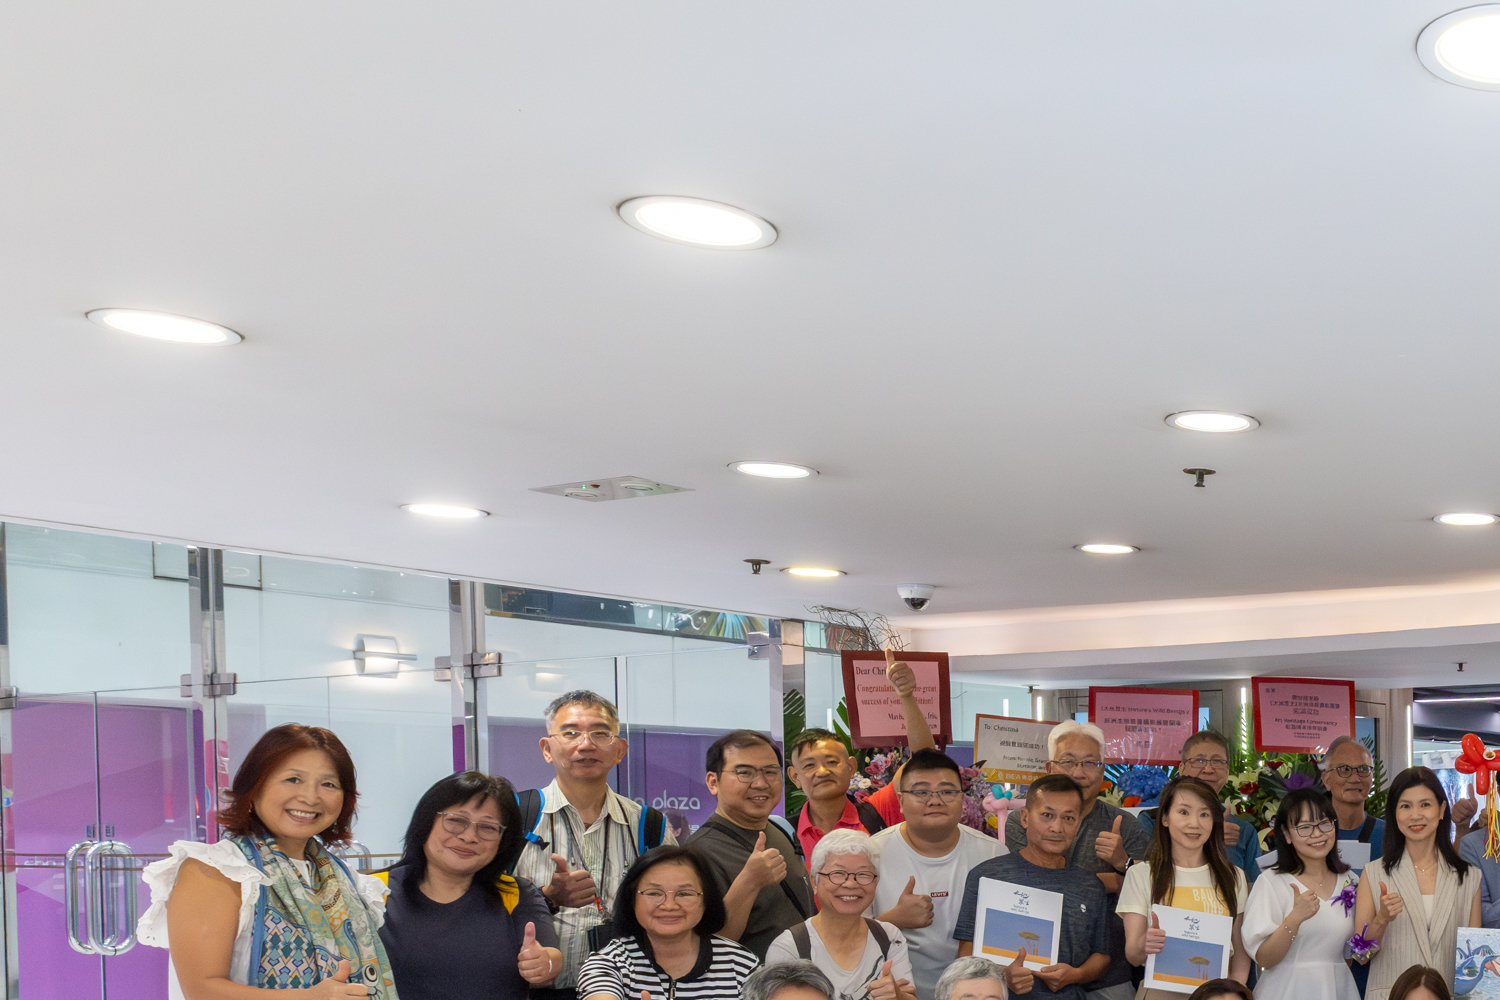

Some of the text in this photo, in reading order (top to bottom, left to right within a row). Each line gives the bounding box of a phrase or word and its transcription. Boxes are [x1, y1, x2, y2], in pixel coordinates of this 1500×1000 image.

[855, 666, 887, 676] Dear Chri
[857, 684, 896, 693] Congratulati
[883, 697, 889, 705] of
[993, 724, 1019, 733] Christina
